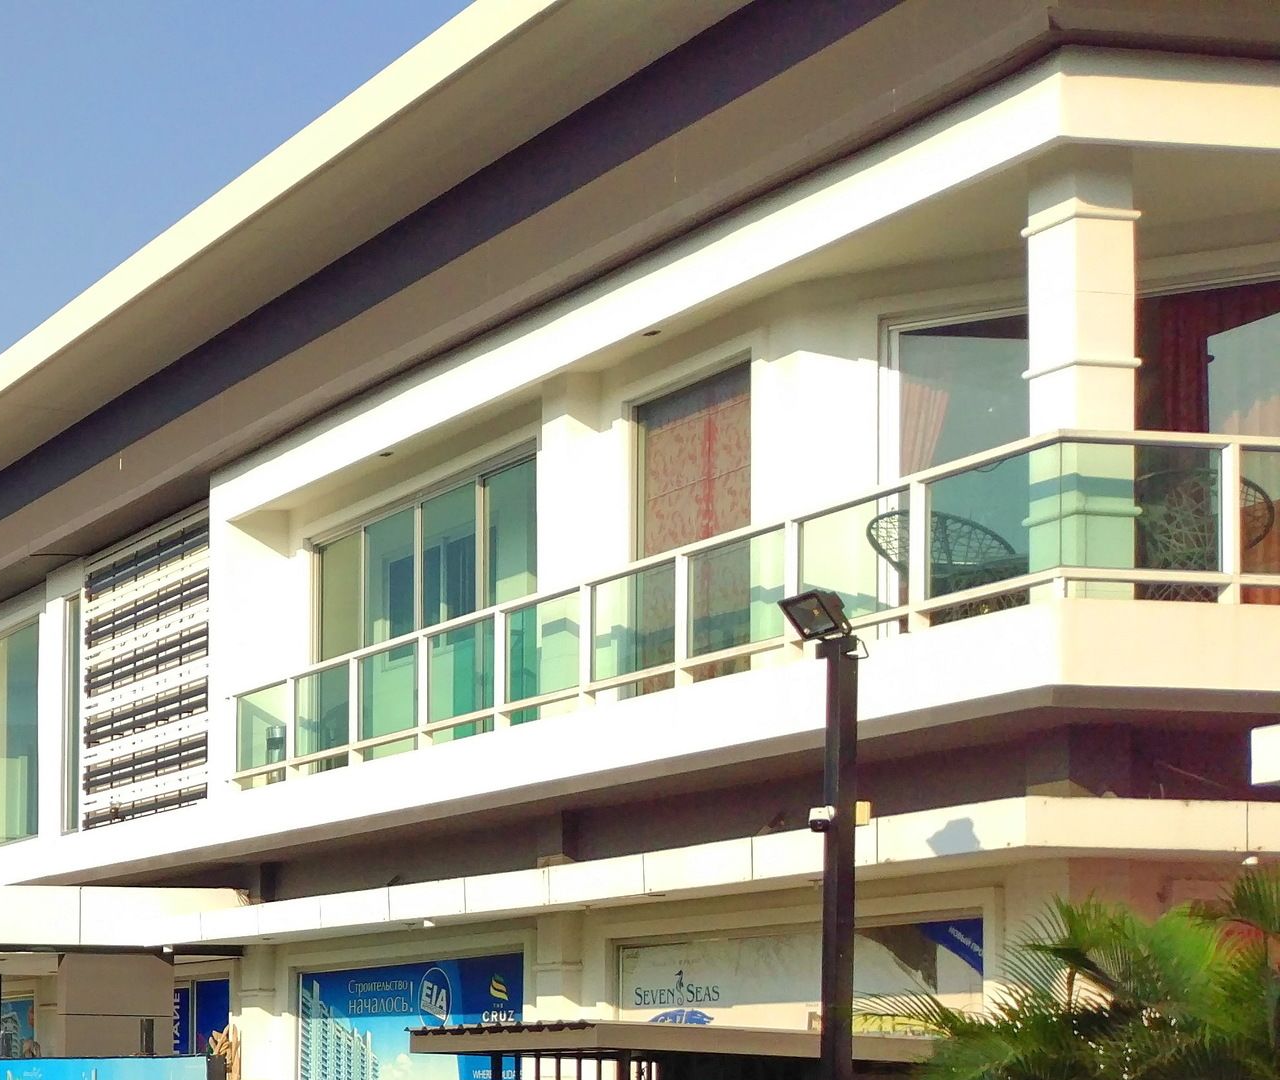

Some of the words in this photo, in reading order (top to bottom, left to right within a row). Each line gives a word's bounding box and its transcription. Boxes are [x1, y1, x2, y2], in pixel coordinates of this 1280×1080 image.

[348, 979, 408, 994] Строительство
[423, 980, 447, 1010] EIA
[482, 1010, 515, 1023] CRUZ
